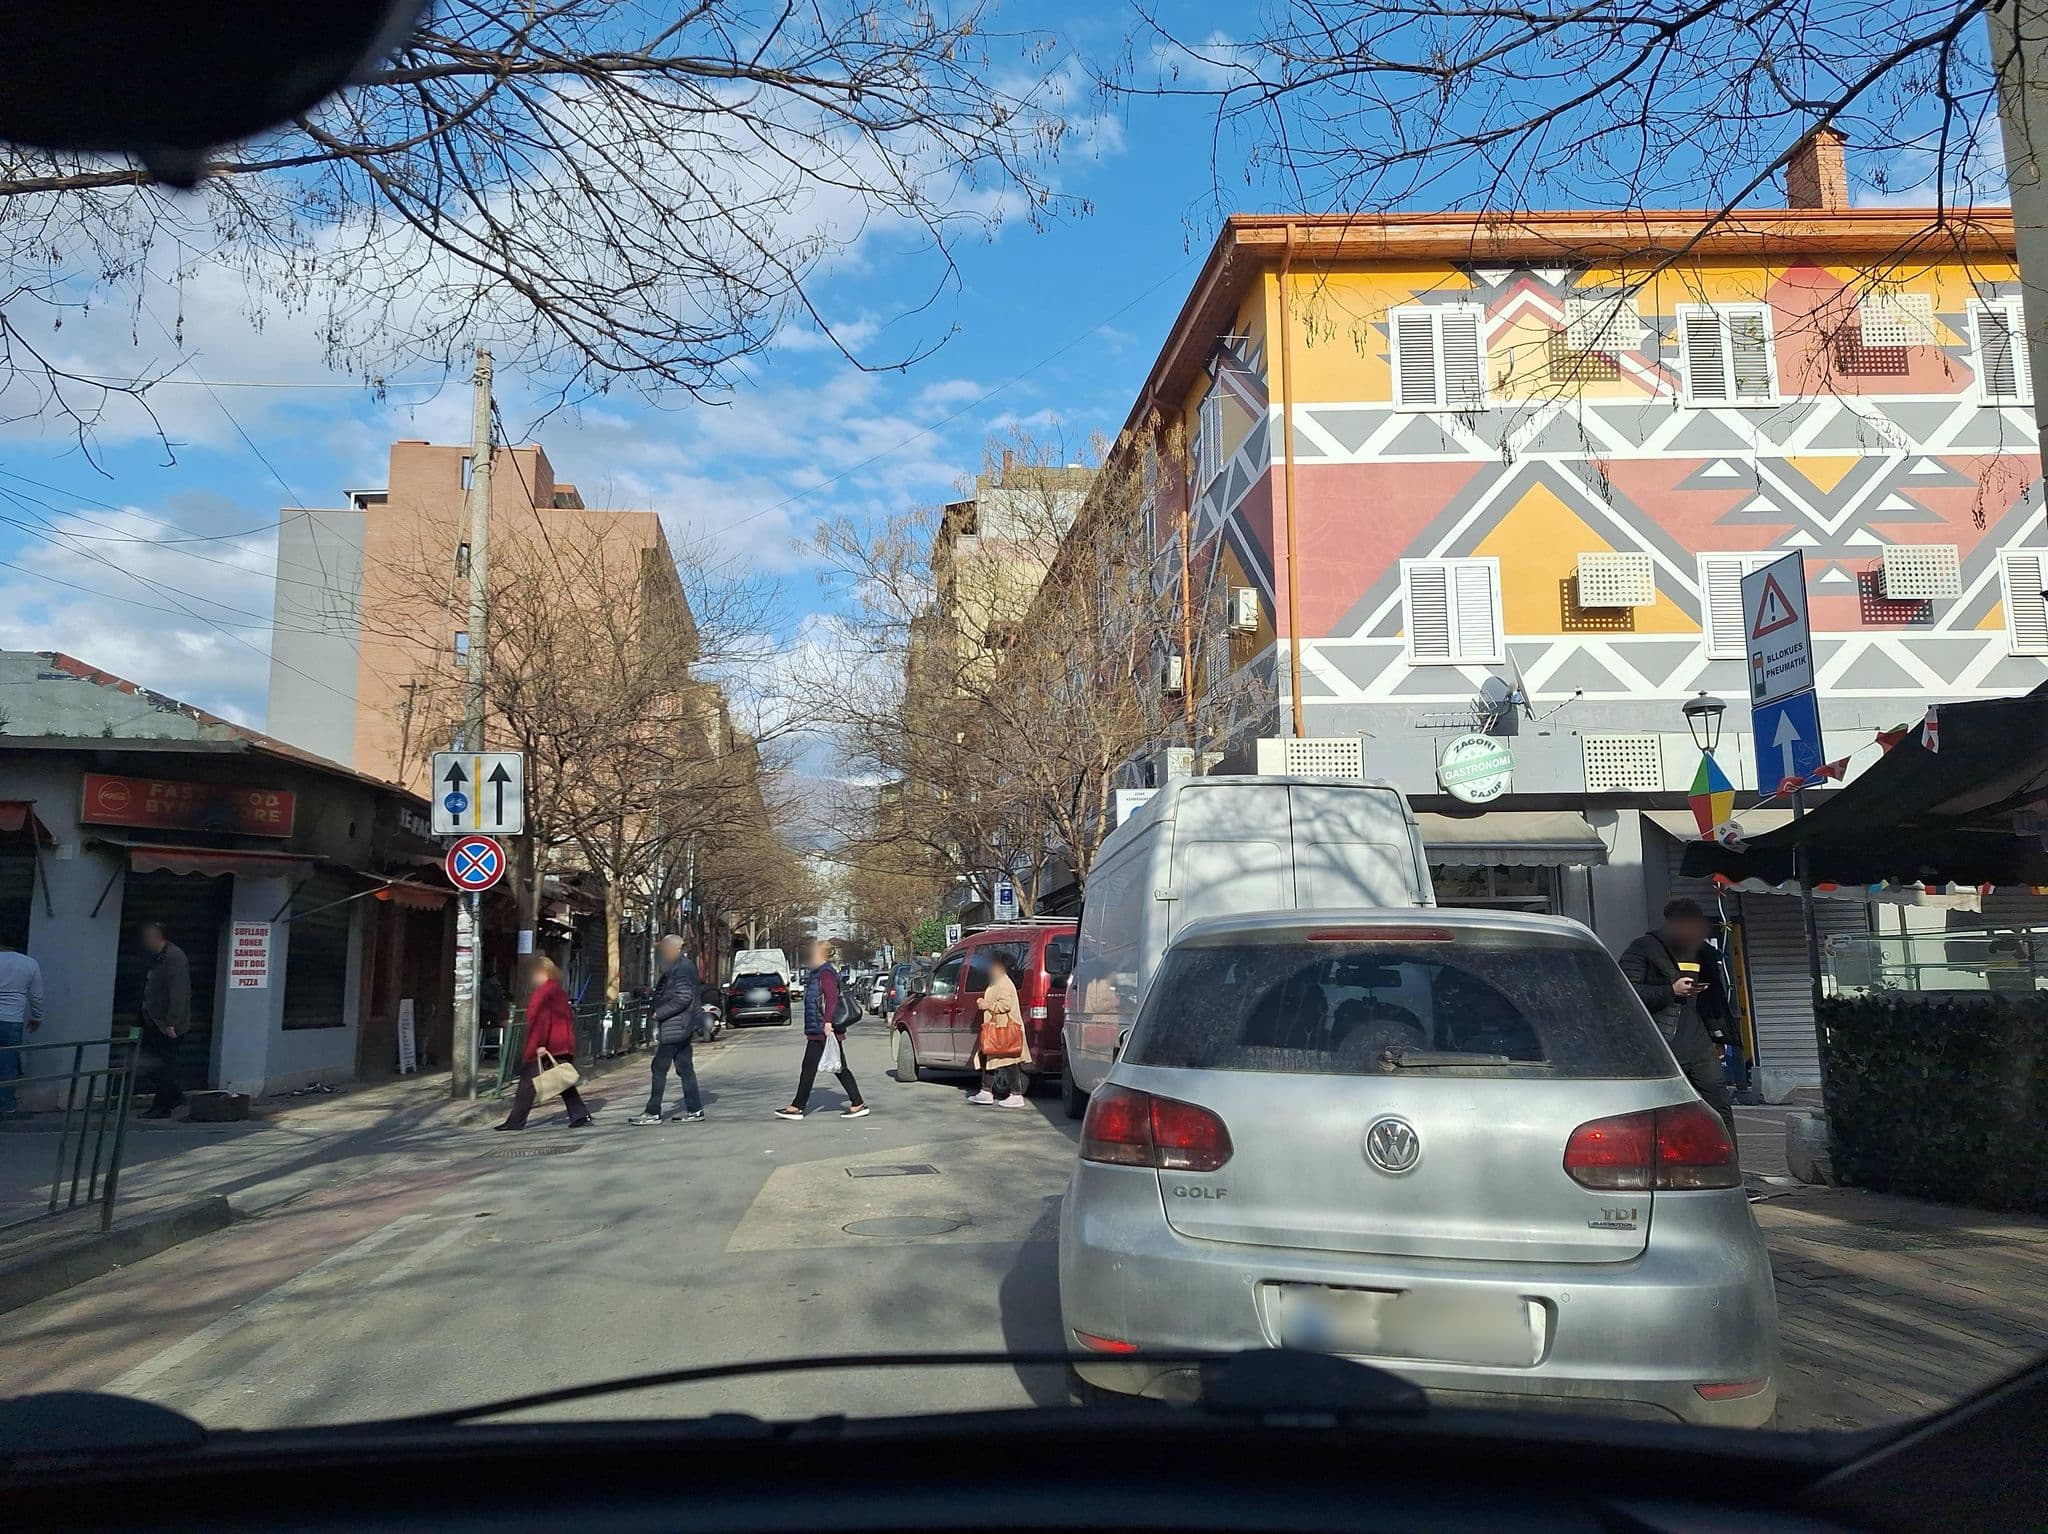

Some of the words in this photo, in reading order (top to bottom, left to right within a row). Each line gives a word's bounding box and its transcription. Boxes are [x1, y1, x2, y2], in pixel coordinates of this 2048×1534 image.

[1766, 642, 1803, 664] BLLOKUES
[1766, 655, 1806, 678] PNEUMATIK
[1453, 738, 1496, 753] ZAGORI
[1445, 755, 1511, 780] GASTRONOMI
[234, 960, 249, 968] HOT
[250, 960, 266, 968] DOG
[239, 978, 258, 987] PIZZA
[1173, 1186, 1228, 1199] GOLF
[1601, 1207, 1637, 1220] TDI
